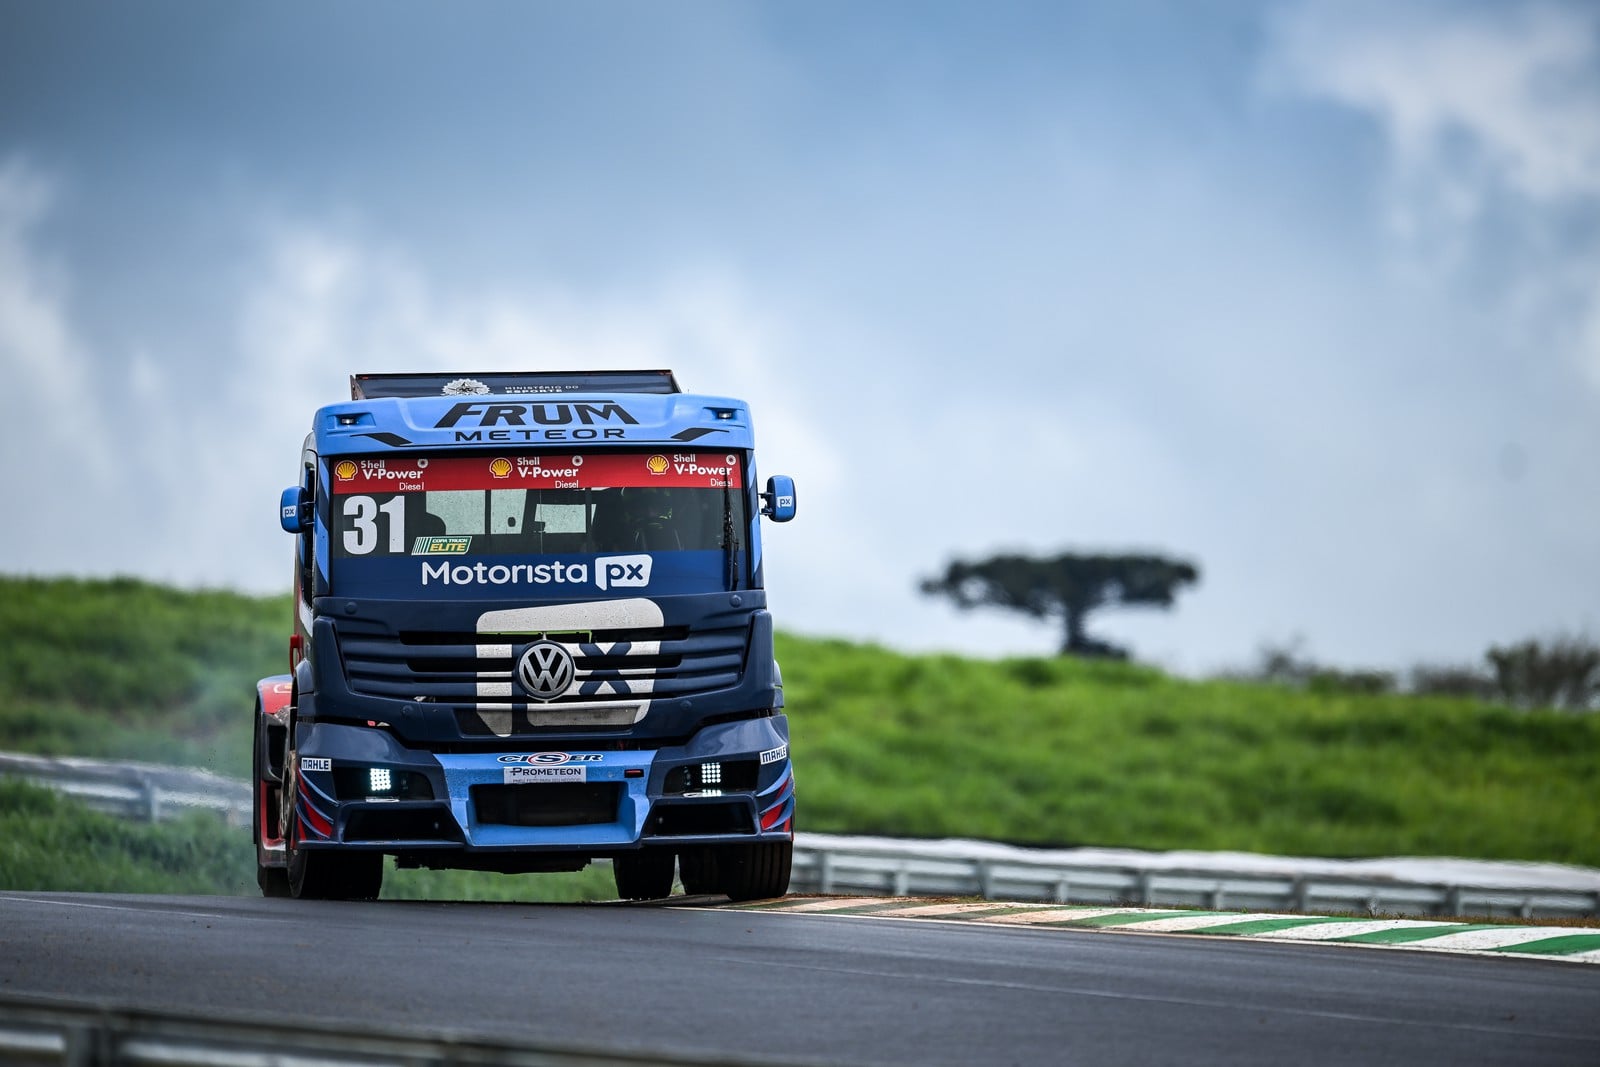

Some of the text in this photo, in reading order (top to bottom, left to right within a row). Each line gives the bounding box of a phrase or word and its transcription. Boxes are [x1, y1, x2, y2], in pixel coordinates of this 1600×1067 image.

[433, 400, 640, 428] FRUM
[455, 428, 626, 441] METEOR
[517, 457, 540, 466] Shell
[673, 454, 696, 463] Shell
[361, 460, 385, 469] Shell
[674, 464, 732, 475] V-Power
[363, 469, 423, 480] V-Power
[518, 467, 578, 478] V-Power
[399, 482, 425, 491] Diesel
[555, 480, 579, 489] Diesel
[779, 497, 791, 507] px
[284, 507, 295, 517] px
[343, 495, 405, 554] 31
[430, 543, 467, 551] ELITE
[422, 560, 647, 588] Motorista px
[519, 644, 574, 695] VW
[498, 752, 603, 765] CISER
[762, 745, 786, 762] MAHLE
[303, 760, 329, 769] MAHLE
[510, 767, 582, 776] PROMETEON
